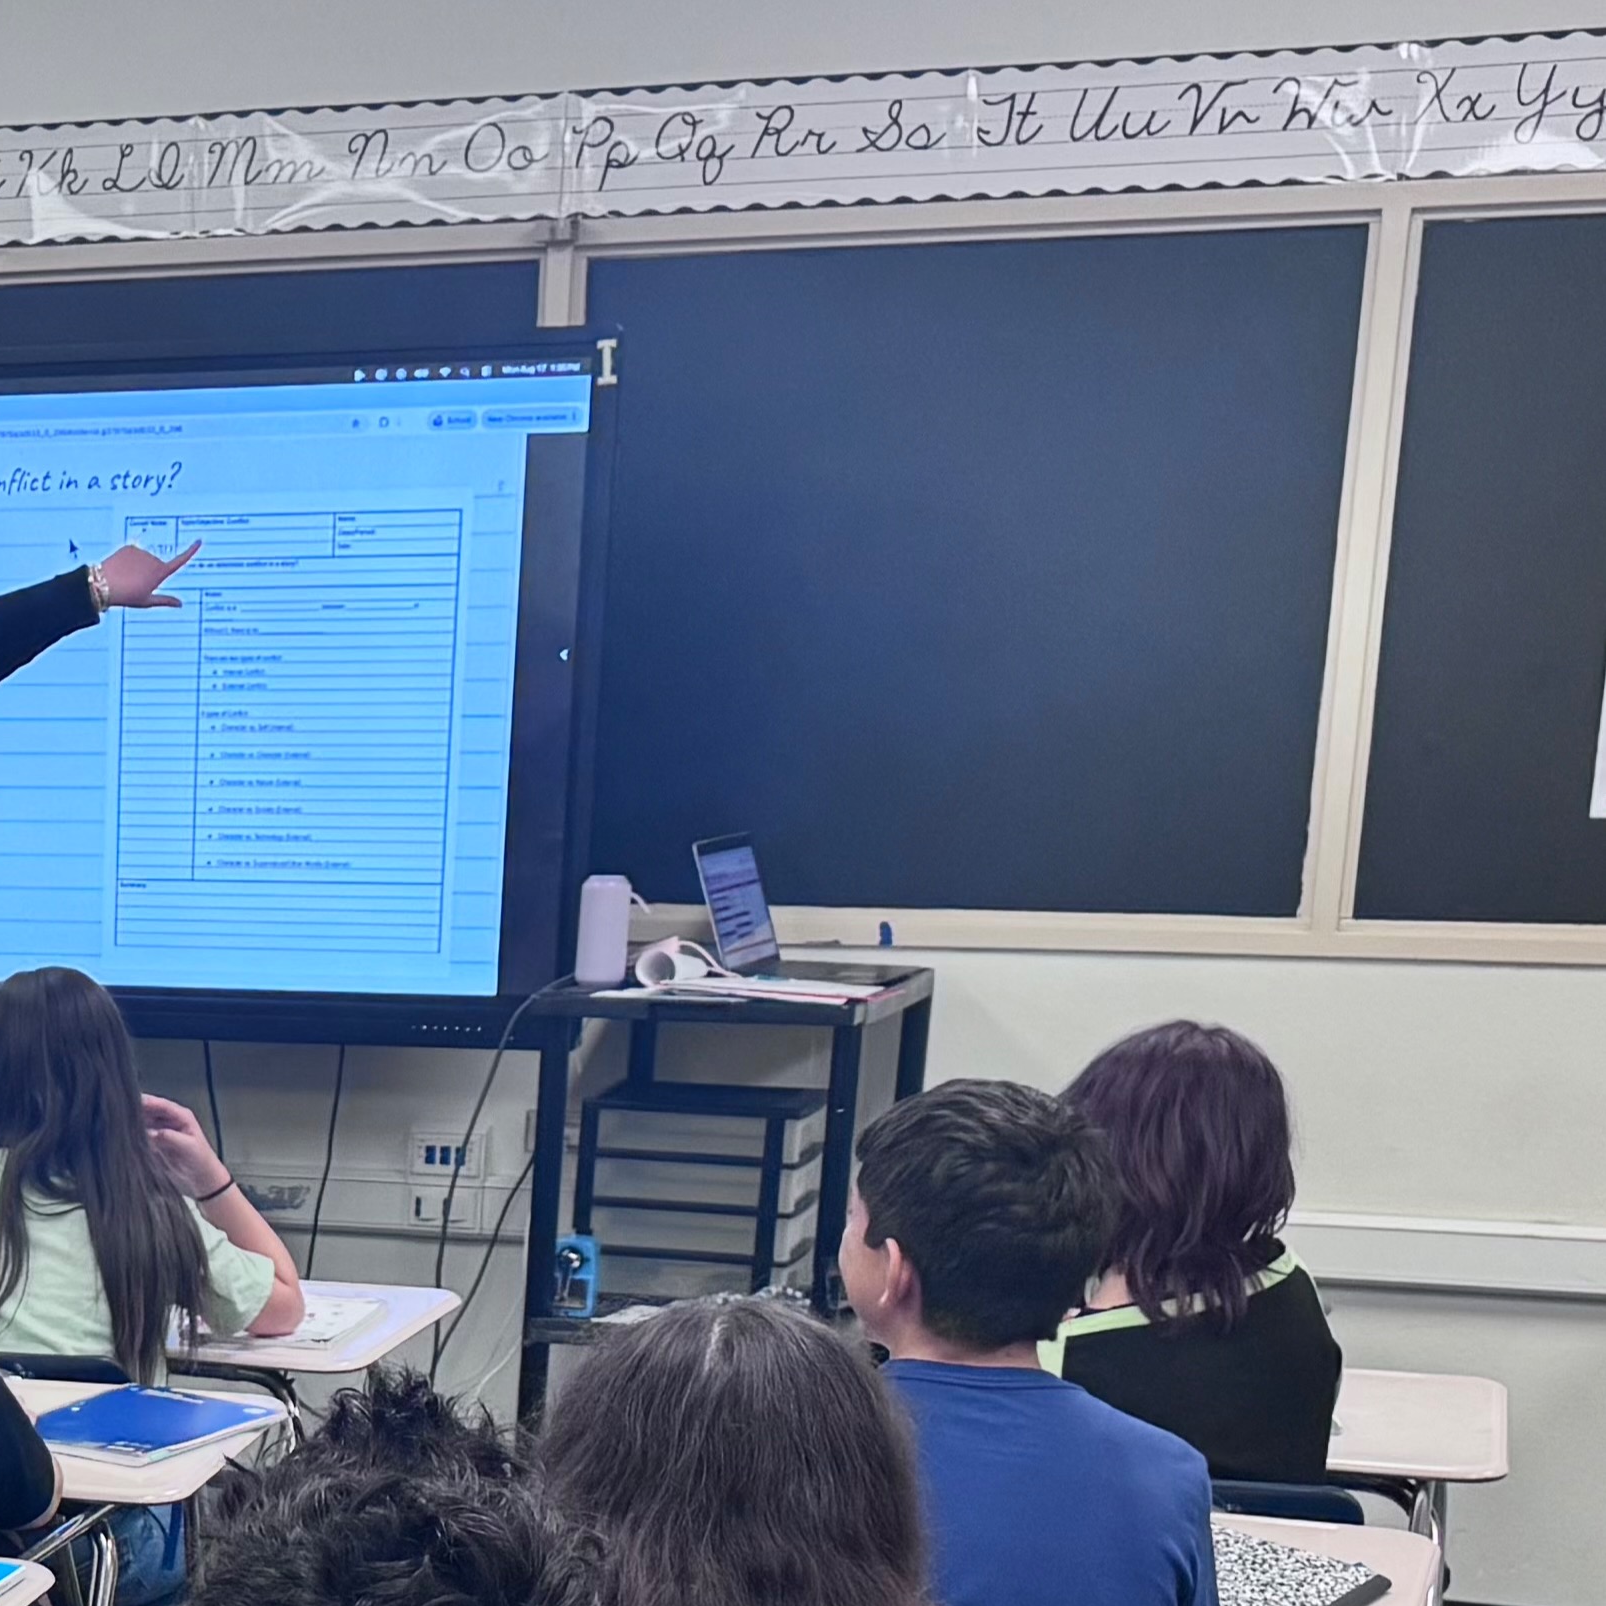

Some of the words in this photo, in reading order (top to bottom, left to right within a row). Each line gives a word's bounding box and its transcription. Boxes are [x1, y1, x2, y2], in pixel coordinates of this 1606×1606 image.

[58, 470, 79, 491] in
[87, 471, 101, 489] a
[110, 461, 183, 495] story?
